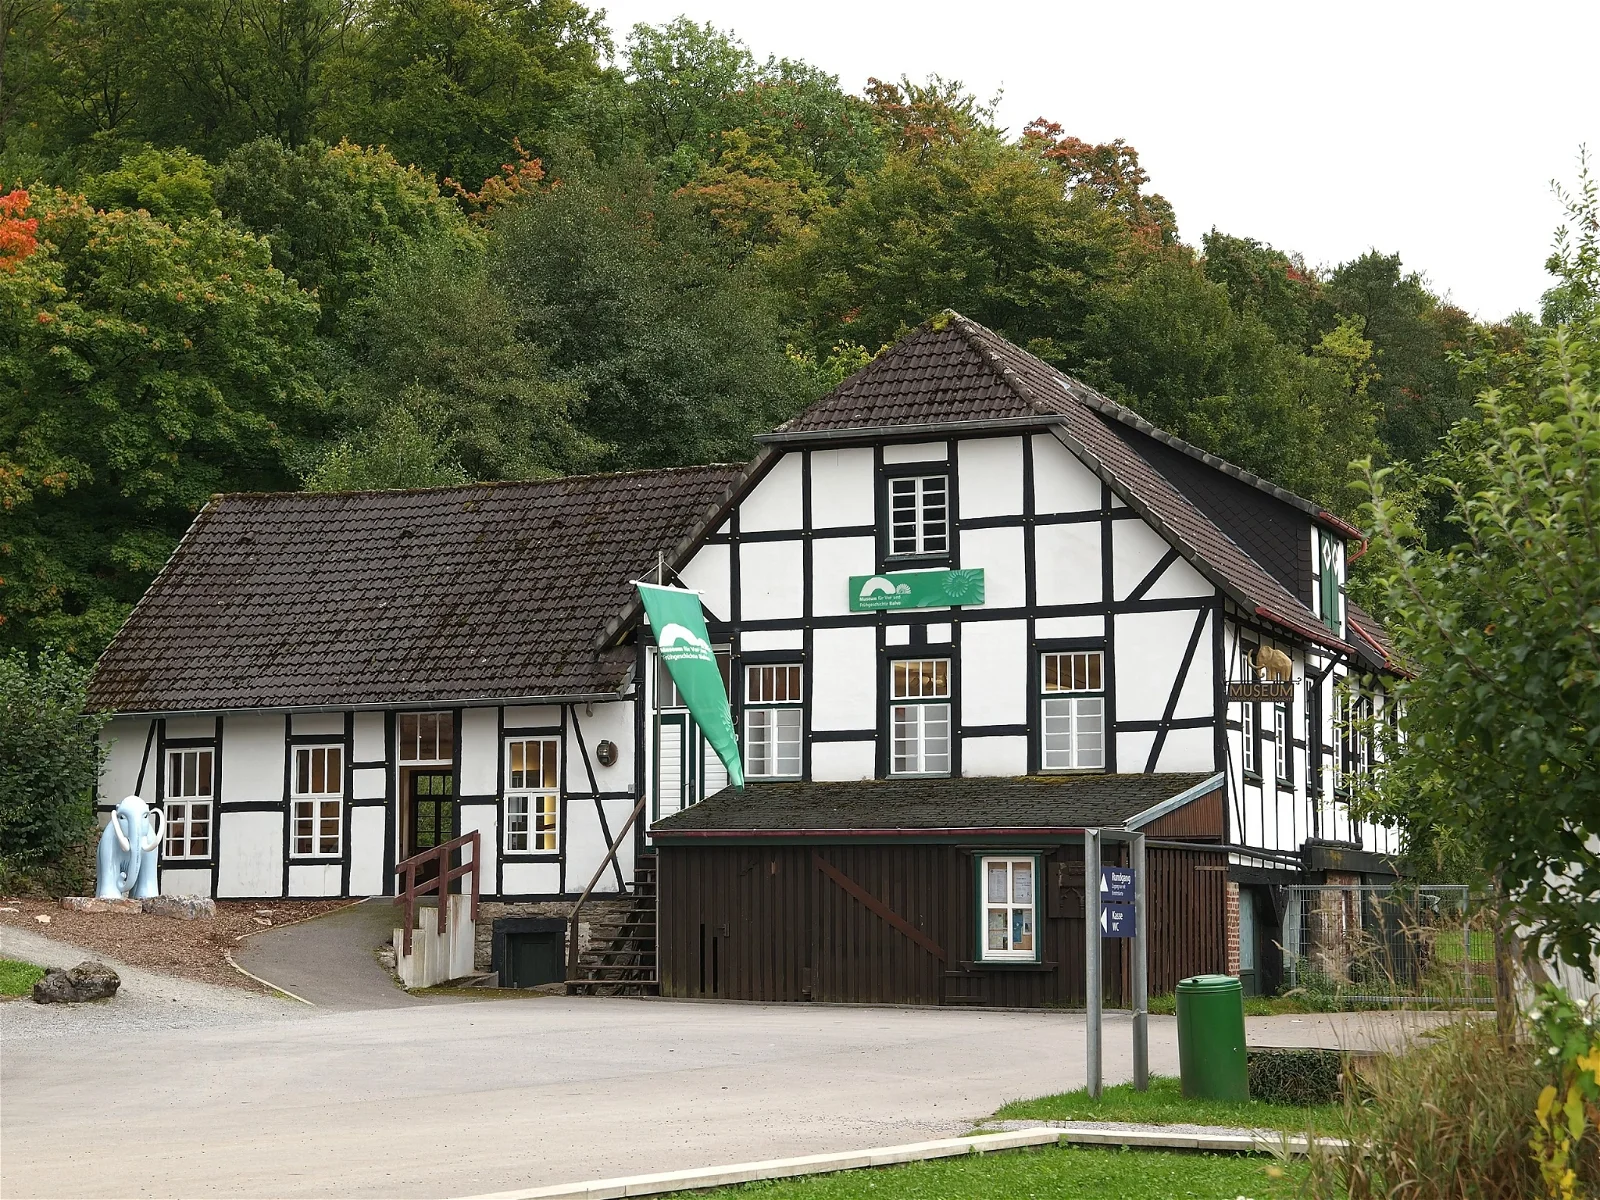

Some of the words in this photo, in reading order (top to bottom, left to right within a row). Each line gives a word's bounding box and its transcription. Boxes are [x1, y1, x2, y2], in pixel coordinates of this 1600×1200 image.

[1230, 684, 1293, 697] MUSEUM
[1112, 872, 1131, 884] Rundgang
[1112, 911, 1123, 920] Kasse
[1112, 922, 1120, 931] WC
